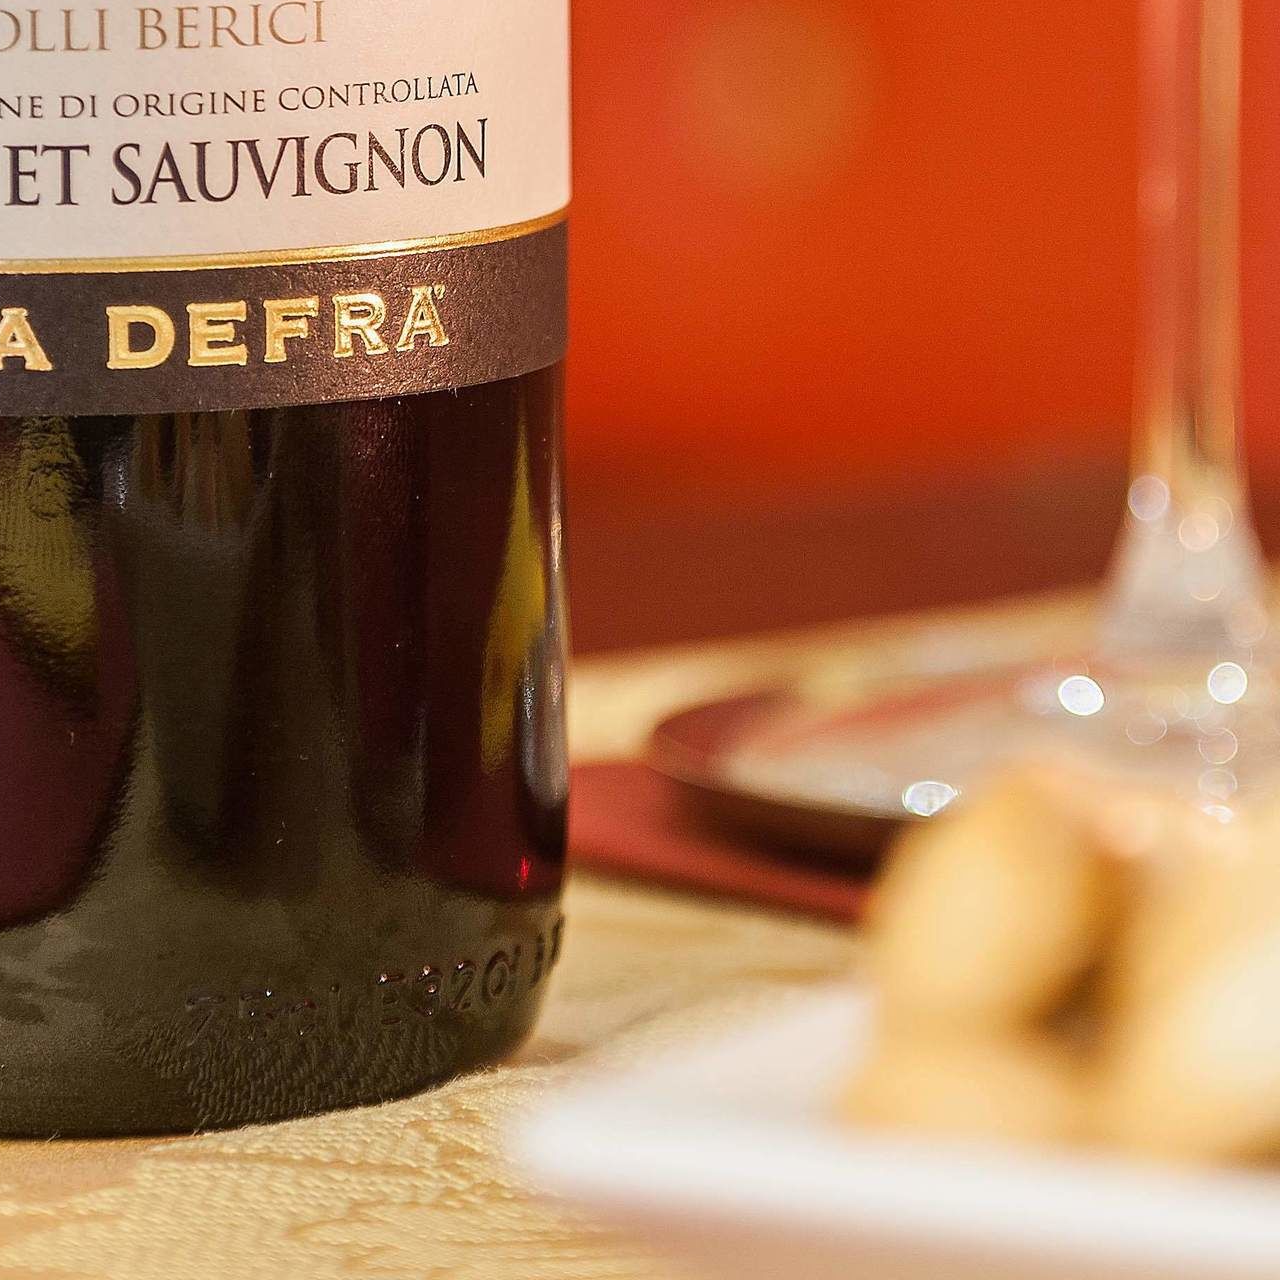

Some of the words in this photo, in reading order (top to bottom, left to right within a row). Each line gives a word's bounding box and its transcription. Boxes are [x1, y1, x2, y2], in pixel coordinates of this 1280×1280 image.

[137, 0, 328, 51] BERICI
[60, 91, 99, 120] DI
[113, 87, 267, 118] ORIGINE
[277, 71, 481, 112] CONTROLLATA
[110, 116, 489, 207] SAUVIGNON
